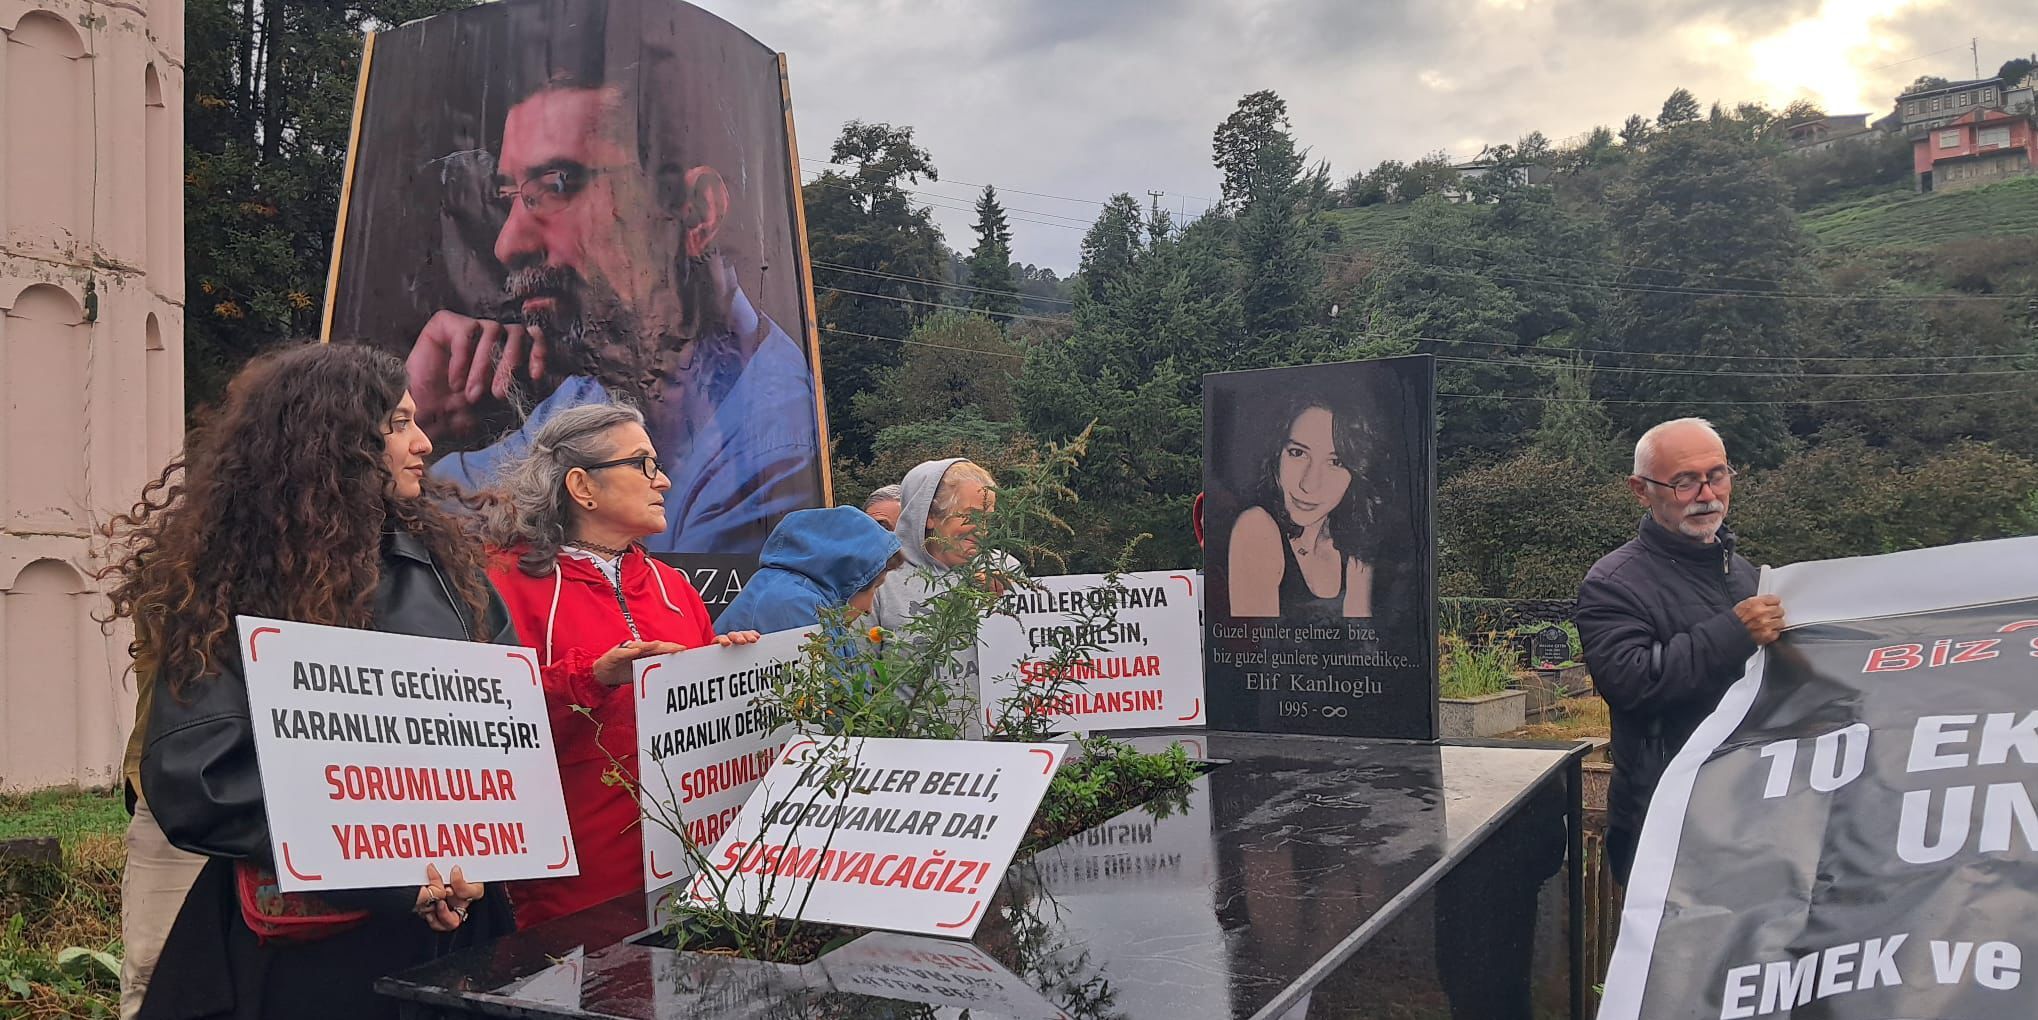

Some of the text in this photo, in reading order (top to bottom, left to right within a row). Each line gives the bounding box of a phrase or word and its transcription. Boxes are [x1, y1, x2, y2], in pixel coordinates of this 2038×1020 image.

[674, 568, 743, 604] ZA
[1294, 625, 1340, 642] gelmez
[1348, 624, 1380, 642] bize,
[1213, 648, 1231, 663] biz
[1862, 639, 2002, 673] Biz
[293, 660, 513, 710] ADALET GECİKİRSE,
[666, 676, 725, 714] ADALET
[1246, 673, 1281, 690] Elif
[1279, 701, 1308, 717] 1995
[271, 708, 541, 755] KARANLIK DERİNLEŞİR!
[651, 715, 732, 761] KARANLIK
[681, 742, 786, 803] SORUMLU
[1759, 722, 1870, 799] 10
[324, 763, 517, 801] SORUMLULAR
[920, 768, 1002, 803] BELLİ,
[763, 801, 945, 836] KORUYANLAR
[942, 812, 999, 840] DA!
[331, 822, 528, 861] YARGILANSIN!
[716, 841, 991, 895] SUSMAYACAĞIZ!
[1720, 933, 2022, 1020] EMEK ve
